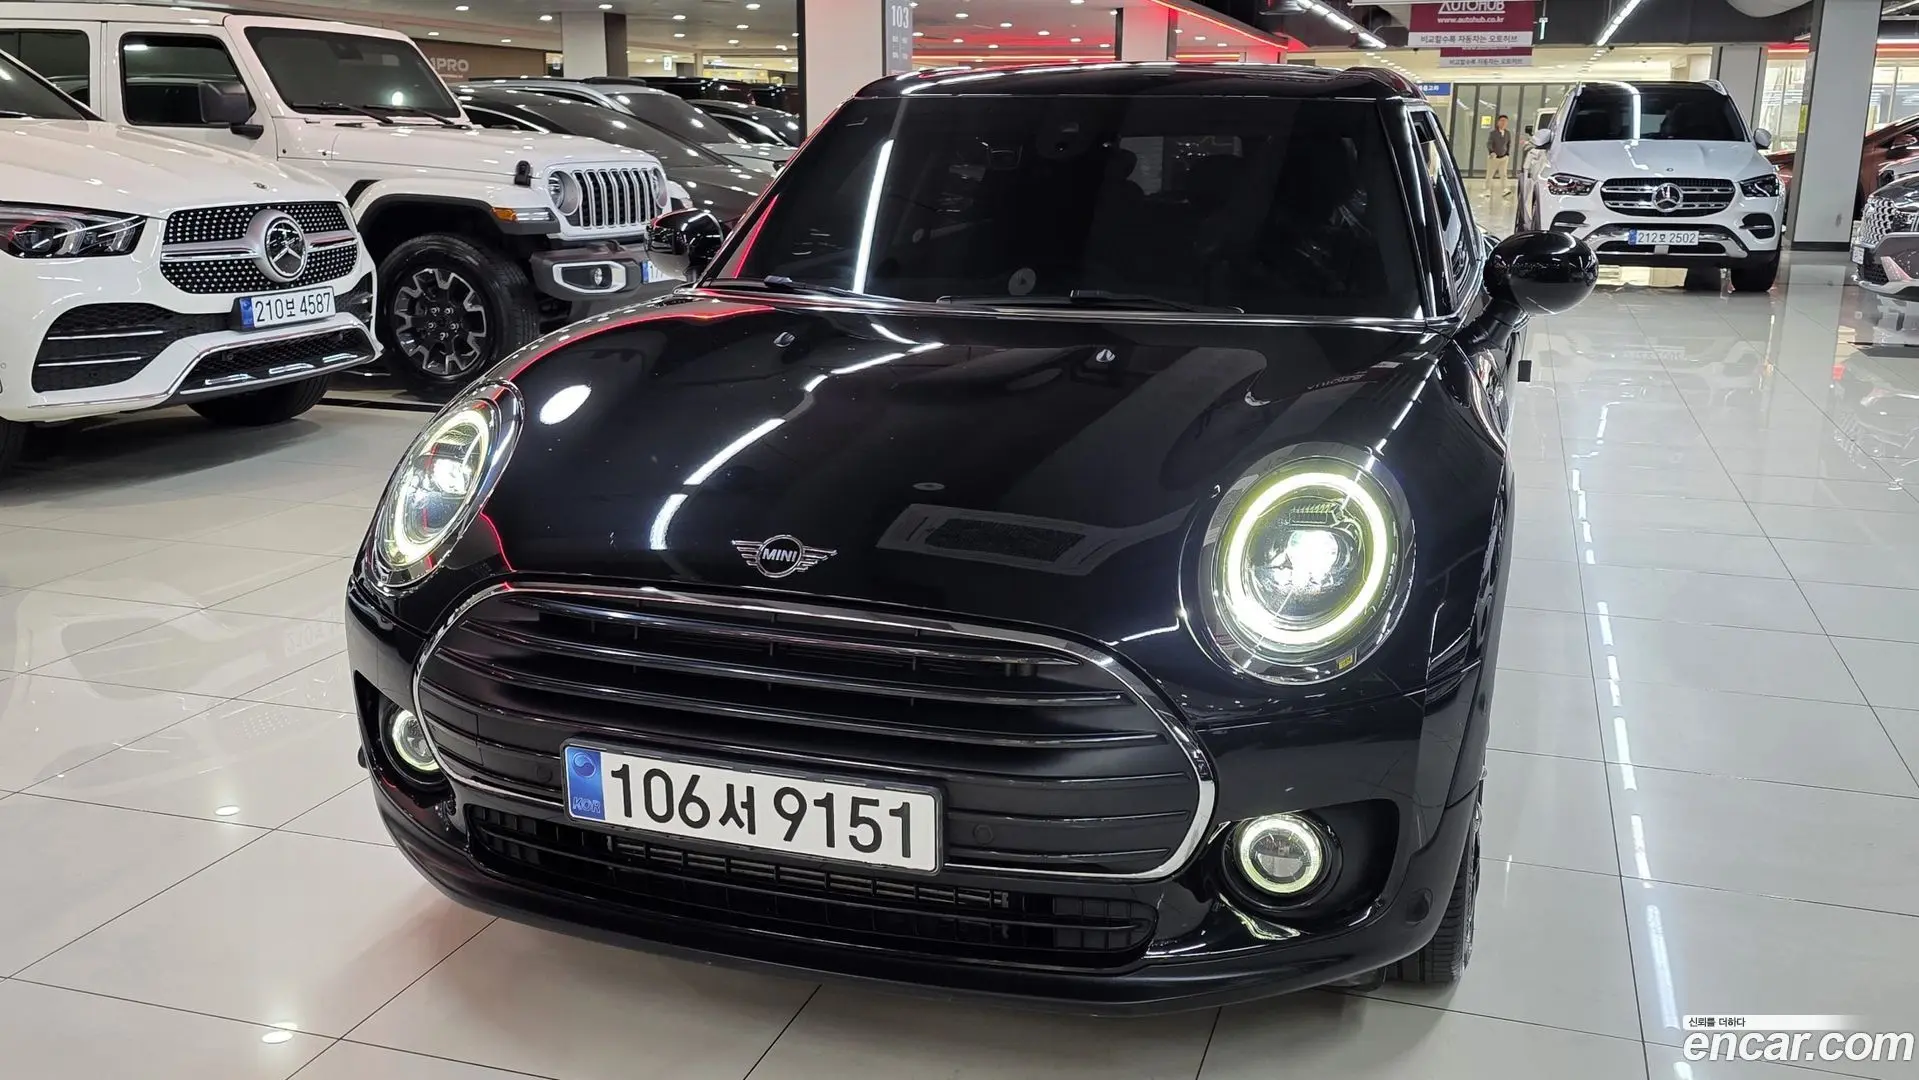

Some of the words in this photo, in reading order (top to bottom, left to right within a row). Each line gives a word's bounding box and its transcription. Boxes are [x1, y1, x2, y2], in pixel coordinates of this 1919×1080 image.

[891, 5, 909, 29] 103
[1420, 35, 1456, 44] 비교할수록
[1458, 35, 1487, 43] 자동차는
[1489, 35, 1518, 43] 오토허브
[1669, 232, 1697, 244] 2502
[255, 298, 296, 322] 210보
[300, 292, 331, 316] 4587
[762, 548, 798, 562] MINI
[573, 796, 601, 814] KOR
[610, 763, 757, 836] 106서
[773, 786, 912, 858] 9151
